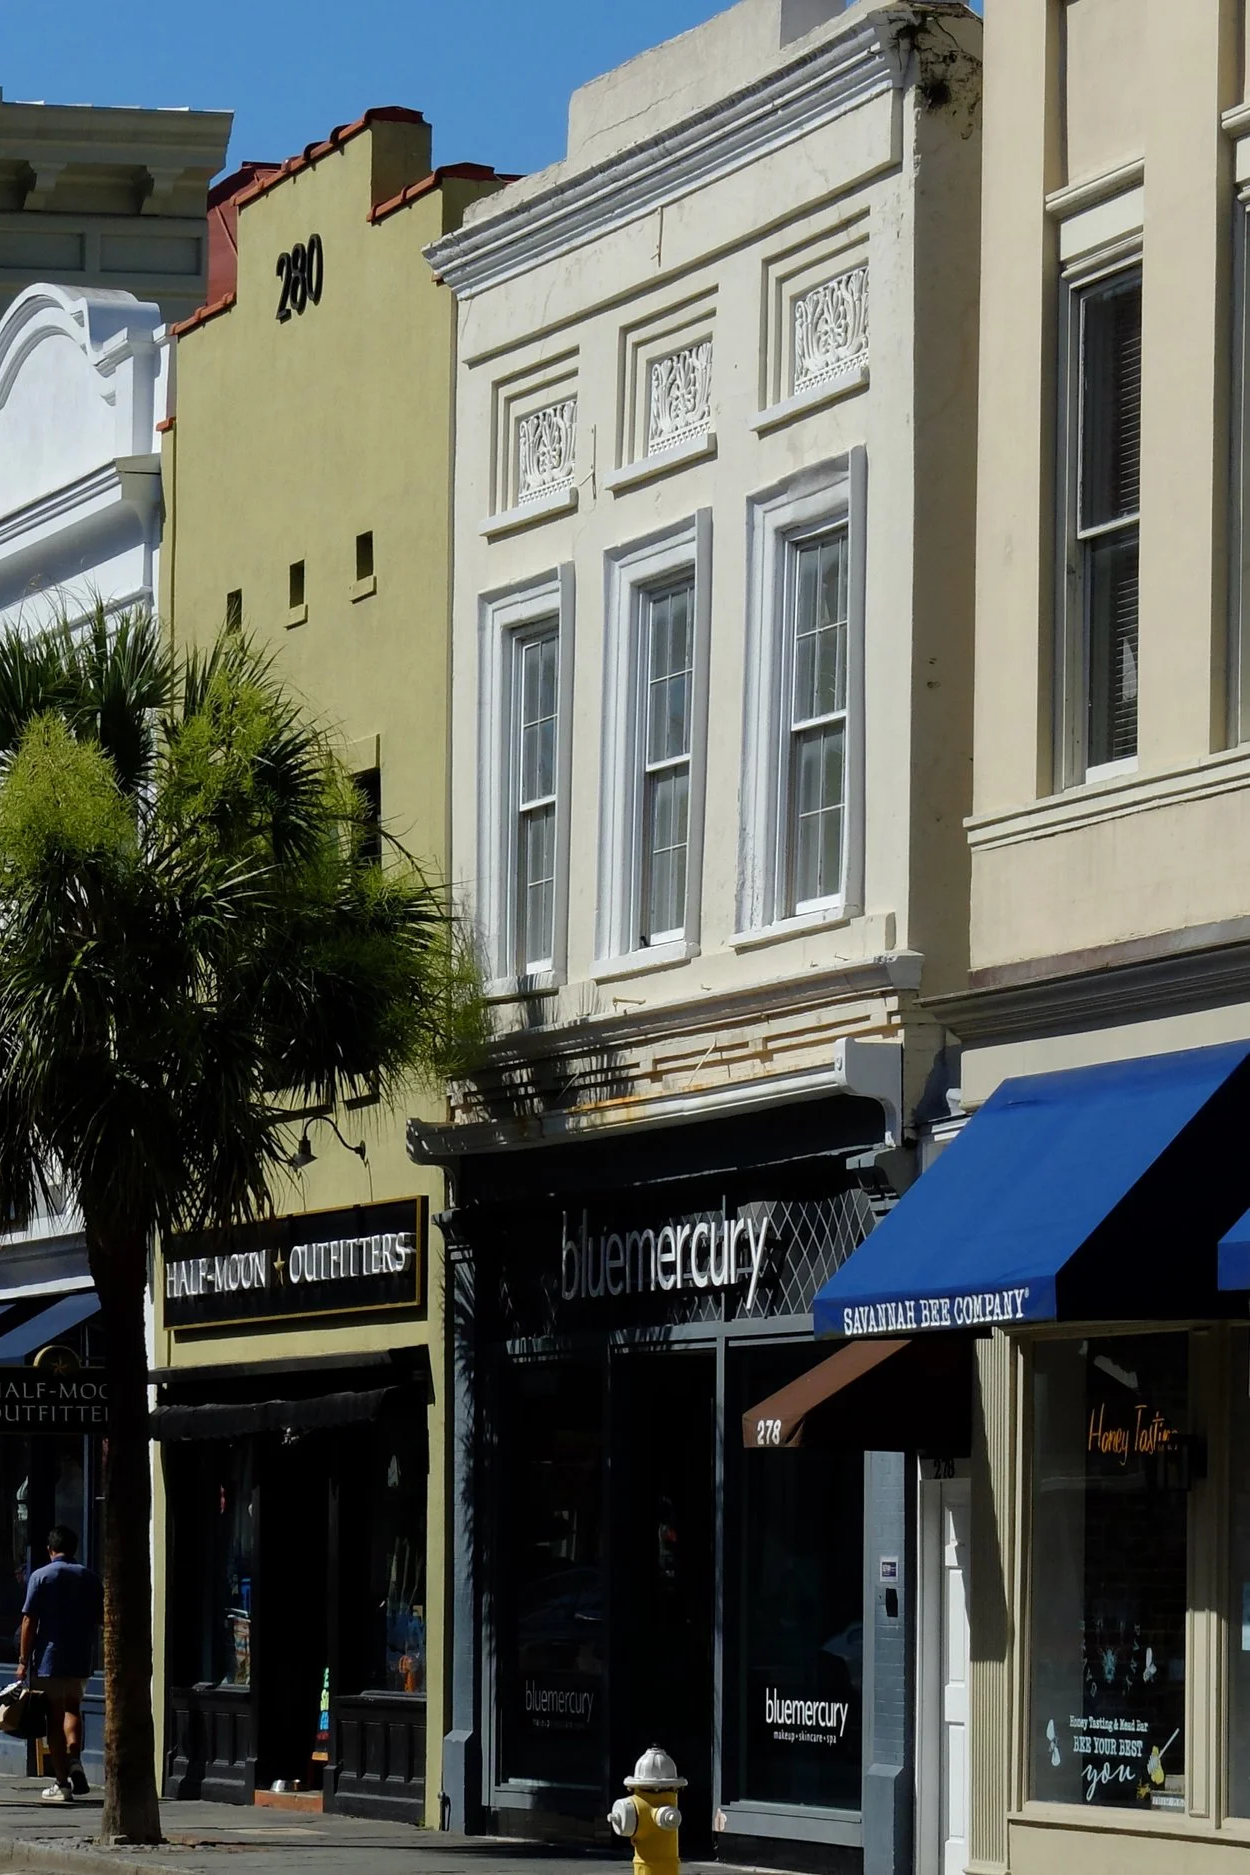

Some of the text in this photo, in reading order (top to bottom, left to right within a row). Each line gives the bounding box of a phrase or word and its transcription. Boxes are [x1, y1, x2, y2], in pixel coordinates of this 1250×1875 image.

[276, 233, 323, 325] 280
[166, 1231, 411, 1299] HALF-MOON OUTFITTERS
[561, 1208, 768, 1310] bluemercury
[843, 1301, 917, 1336] SAVANNAH
[920, 1297, 950, 1327] BEE
[757, 1420, 782, 1445] 278
[1088, 1402, 1129, 1466] Honey
[934, 1459, 955, 1479] 278
[525, 1680, 594, 1723] bluemercury
[766, 1687, 849, 1737] bluemercury
[1069, 1715, 1087, 1731] Honey
[1089, 1716, 1113, 1733] Tasting
[1073, 1735, 1144, 1758] BEE YOUR BEST
[1081, 1762, 1136, 1801] you
